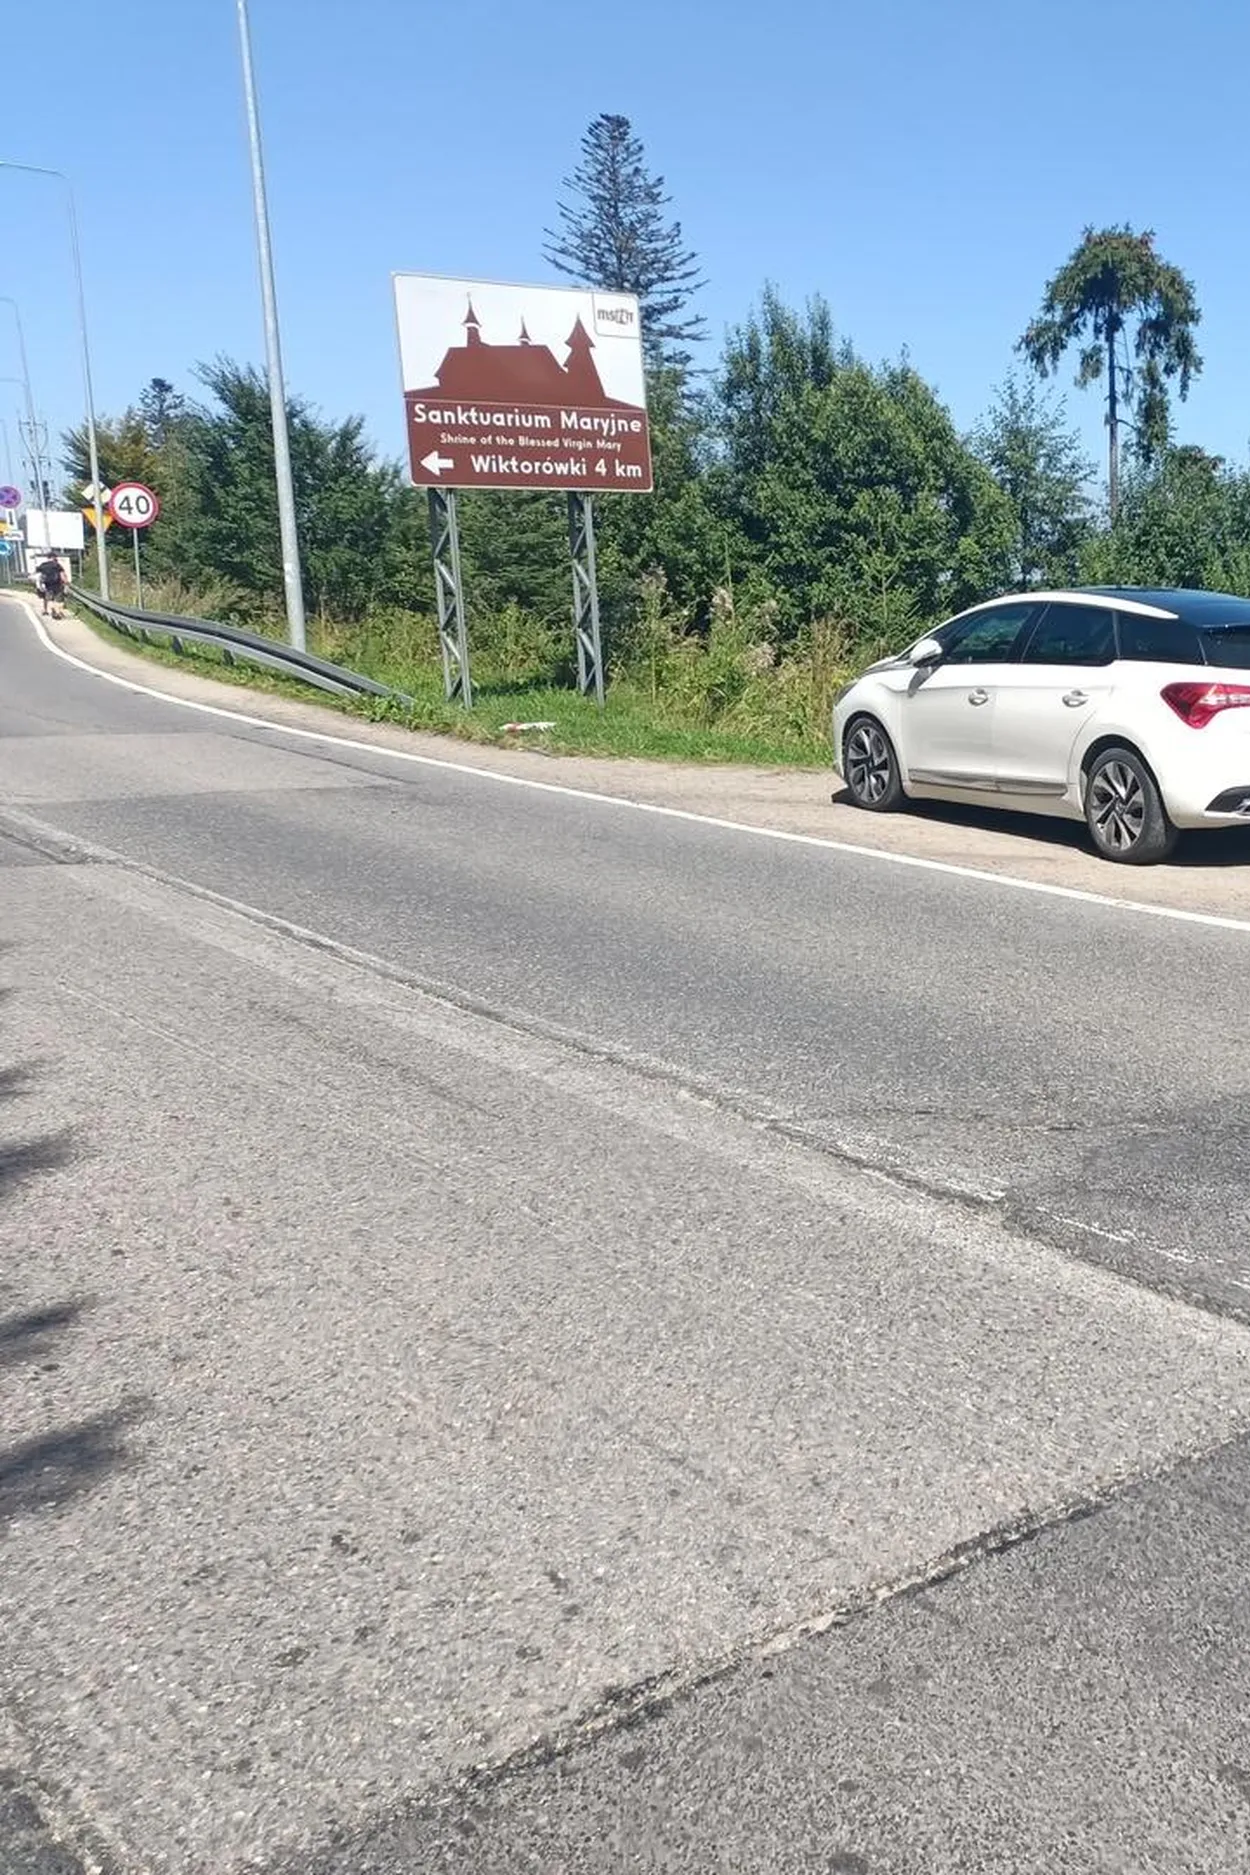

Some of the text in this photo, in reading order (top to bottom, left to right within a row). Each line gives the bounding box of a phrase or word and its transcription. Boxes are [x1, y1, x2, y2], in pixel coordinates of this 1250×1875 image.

[414, 403, 642, 436] Sanktuarium Maryjne
[440, 432, 622, 453] Shrine of the Blessed Virgin Mary
[470, 453, 643, 478] Wiktorówki 4 km
[118, 495, 151, 515] 40
